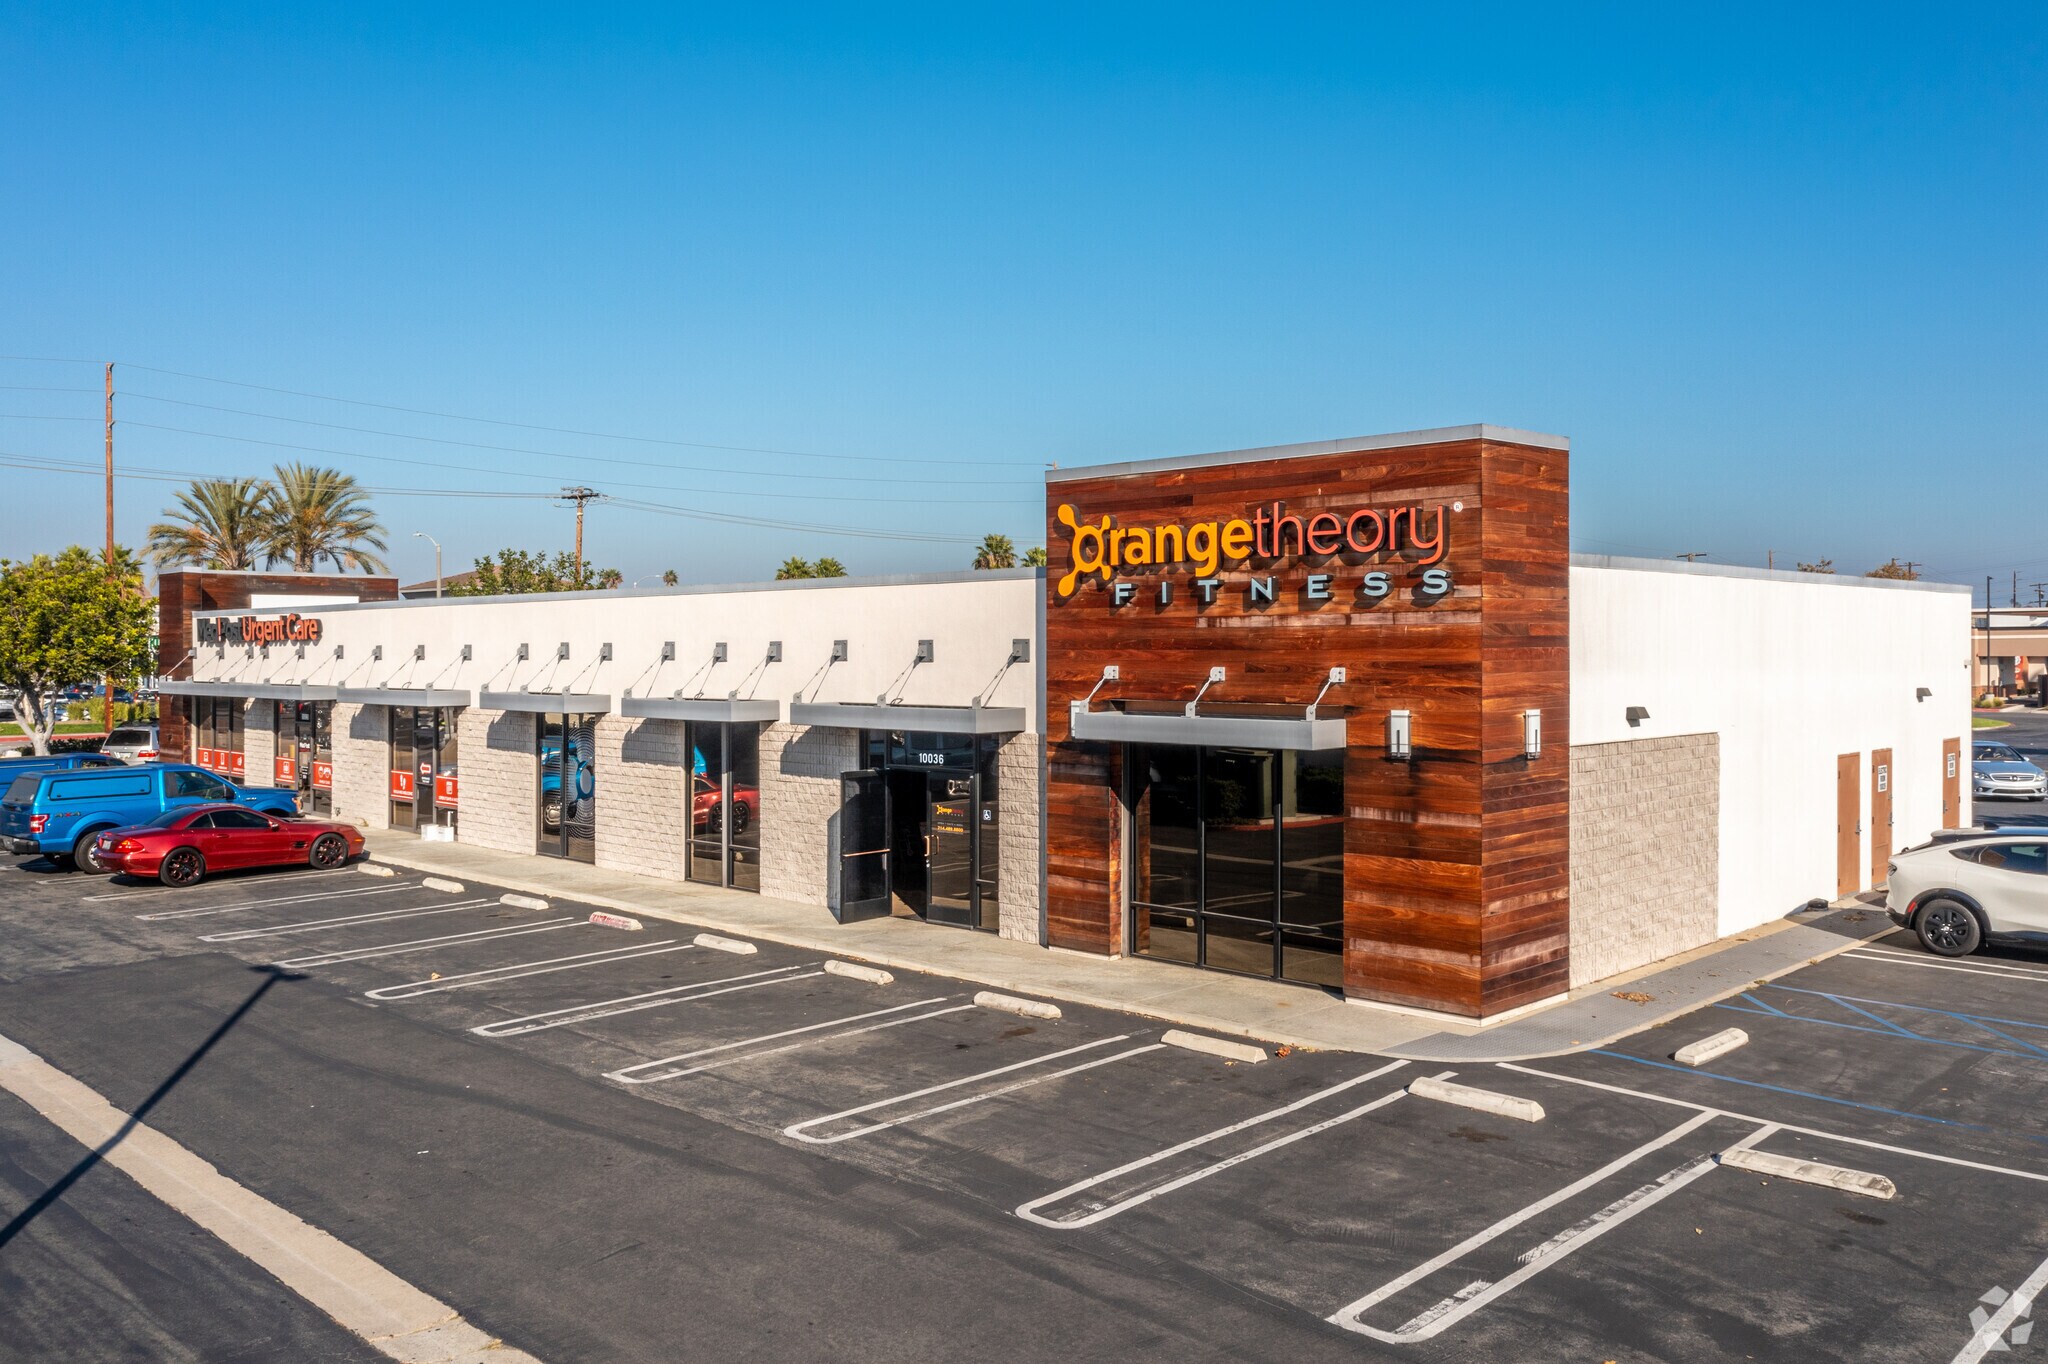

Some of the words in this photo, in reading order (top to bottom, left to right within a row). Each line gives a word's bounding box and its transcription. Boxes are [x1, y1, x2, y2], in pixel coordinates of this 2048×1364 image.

[1115, 569, 1448, 604] FITNESS
[242, 616, 284, 646] Urgent
[287, 613, 317, 640] Care
[919, 753, 944, 764] 10036
